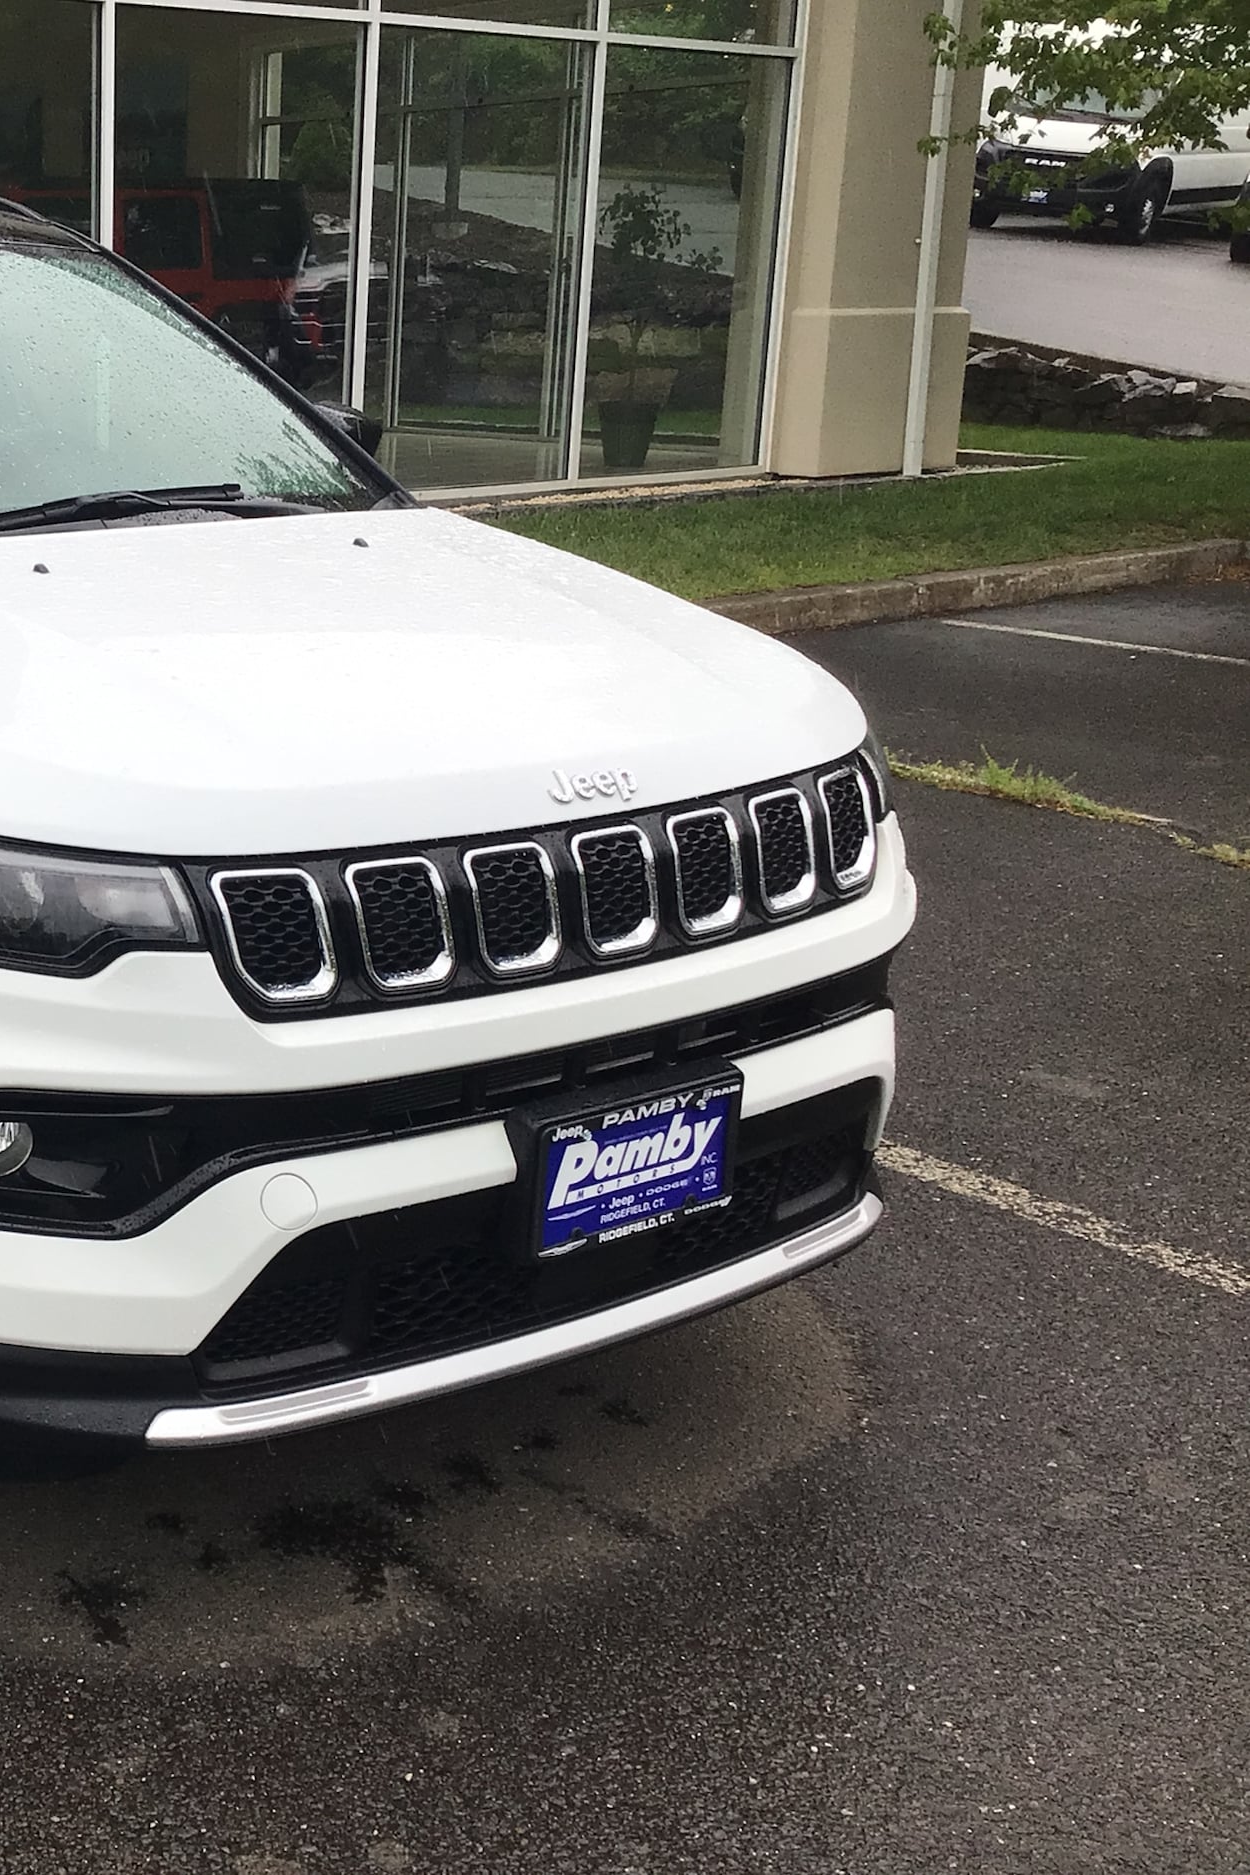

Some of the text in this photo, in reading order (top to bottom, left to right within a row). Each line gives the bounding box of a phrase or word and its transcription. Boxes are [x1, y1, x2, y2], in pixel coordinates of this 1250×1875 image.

[1024, 157, 1067, 168] RAM
[547, 767, 638, 804] Jeep
[713, 1084, 741, 1097] RAM
[601, 1092, 695, 1129] PAMBY
[552, 1124, 584, 1143] Jeep
[547, 1113, 723, 1210] Pamby
[577, 1164, 676, 1200] MOTORS
[608, 1179, 689, 1209] Jeep DODGE
[599, 1212, 675, 1243] RIDGEFIELD, CT.
